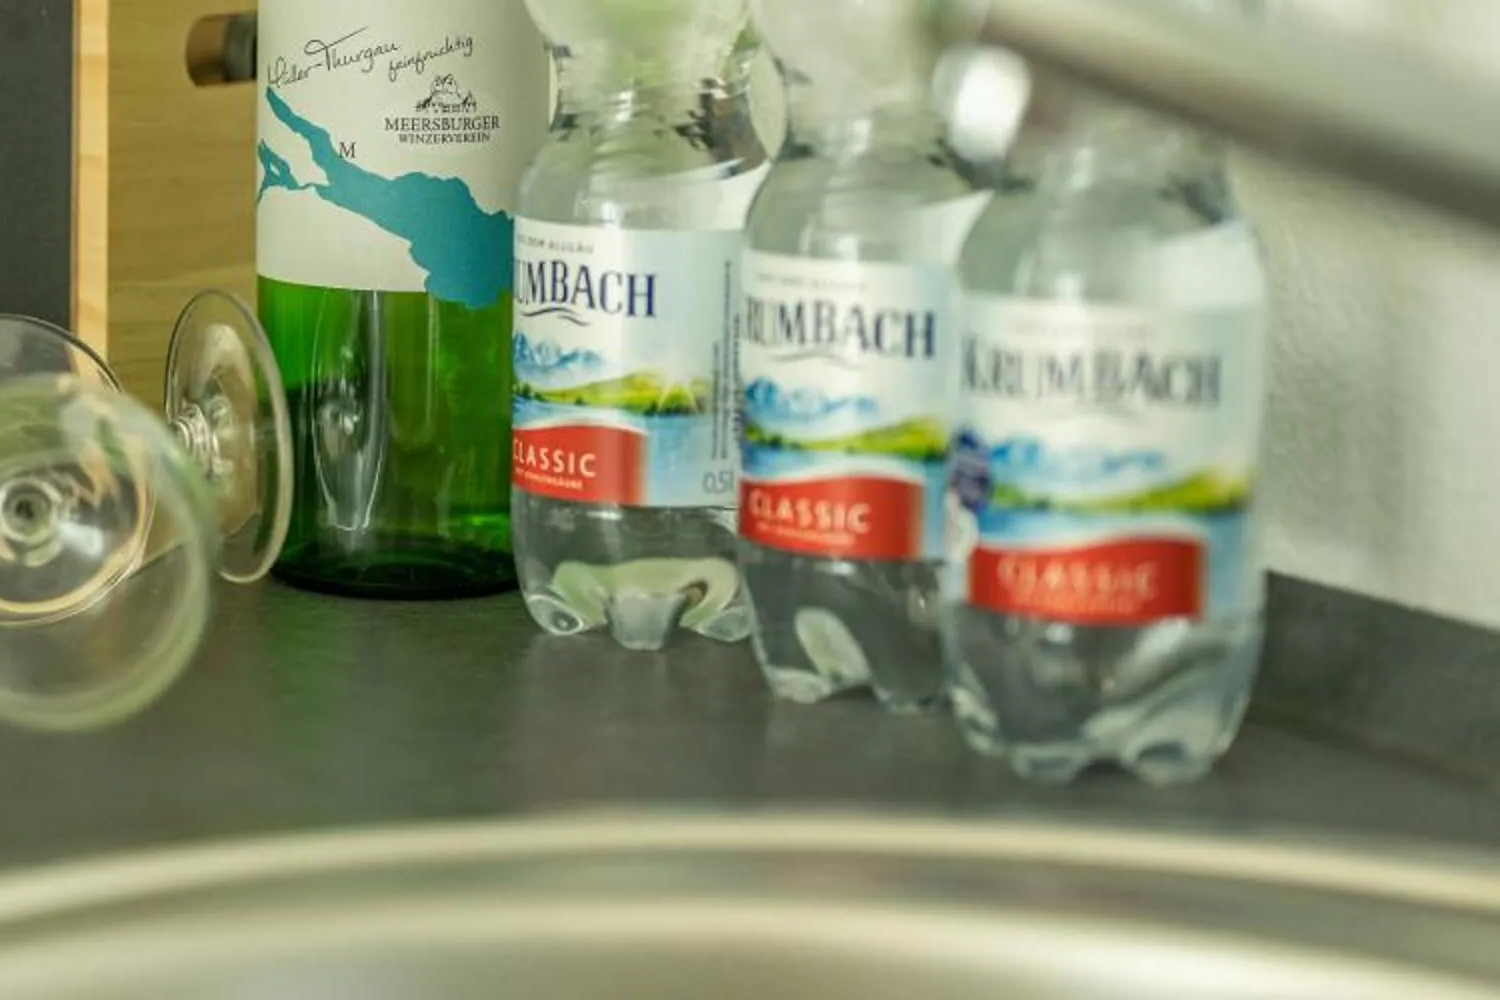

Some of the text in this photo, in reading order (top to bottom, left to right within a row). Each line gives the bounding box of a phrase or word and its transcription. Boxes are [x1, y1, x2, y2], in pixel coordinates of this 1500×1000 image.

[385, 115, 500, 131] MEERSBURGER
[398, 132, 492, 144] WINZERVEREIN
[339, 142, 357, 159] M
[514, 258, 657, 317] UMBACH
[745, 297, 936, 359] RUMBACH
[513, 437, 596, 478] CLASSIC
[750, 488, 872, 535] CLASSIC
